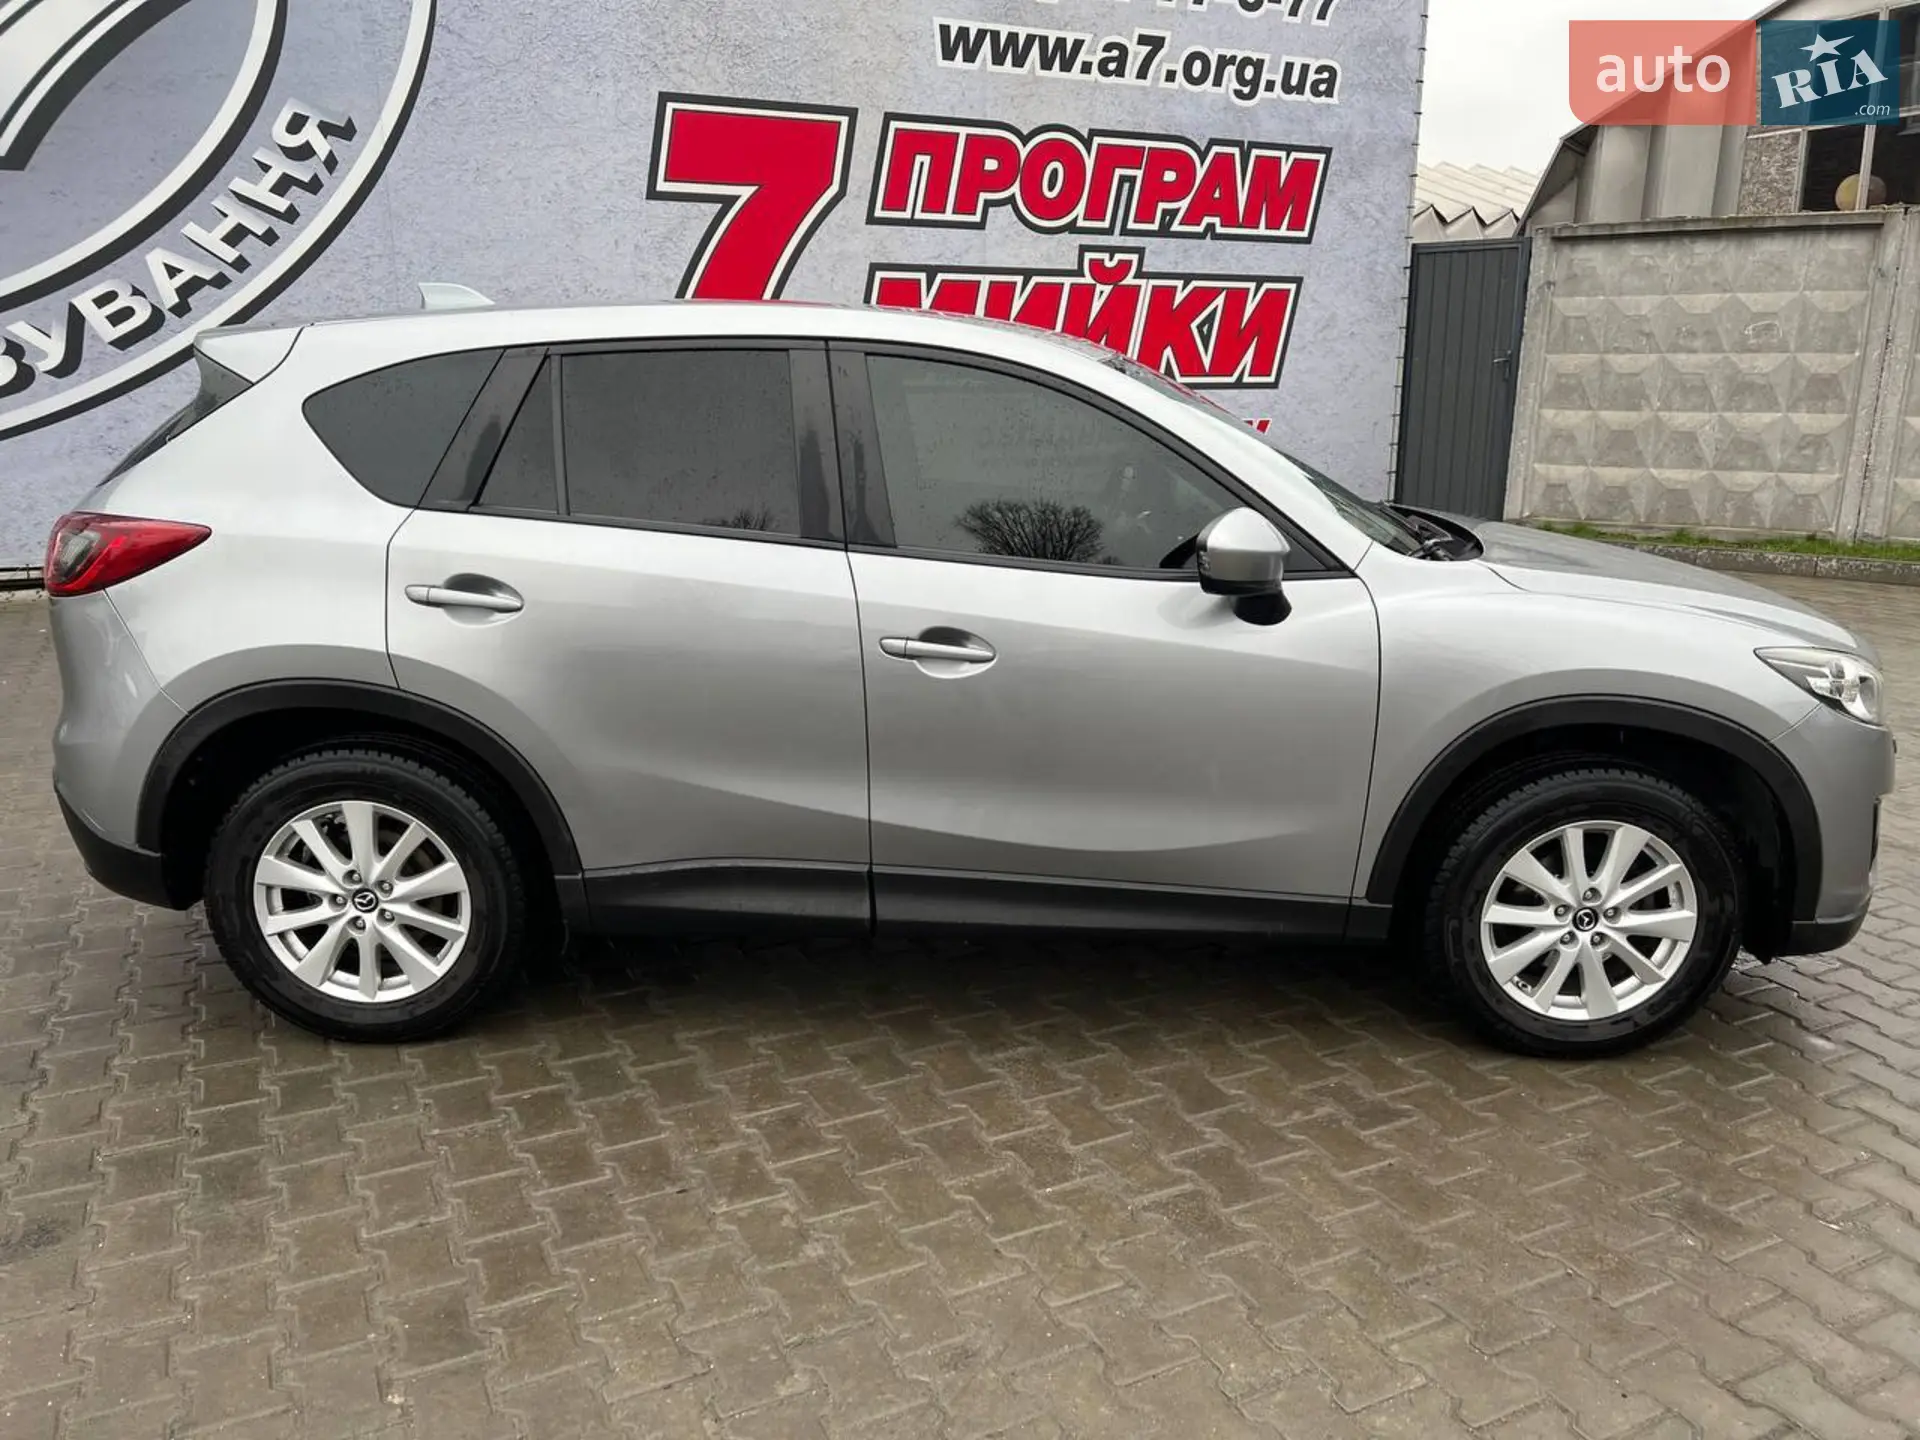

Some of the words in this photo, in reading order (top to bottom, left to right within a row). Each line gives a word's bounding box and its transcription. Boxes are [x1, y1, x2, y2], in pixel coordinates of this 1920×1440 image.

[938, 22, 1340, 102] www.a7.org.ua
[650, 94, 855, 301] 7
[870, 116, 1328, 240] ПРОГРАМ
